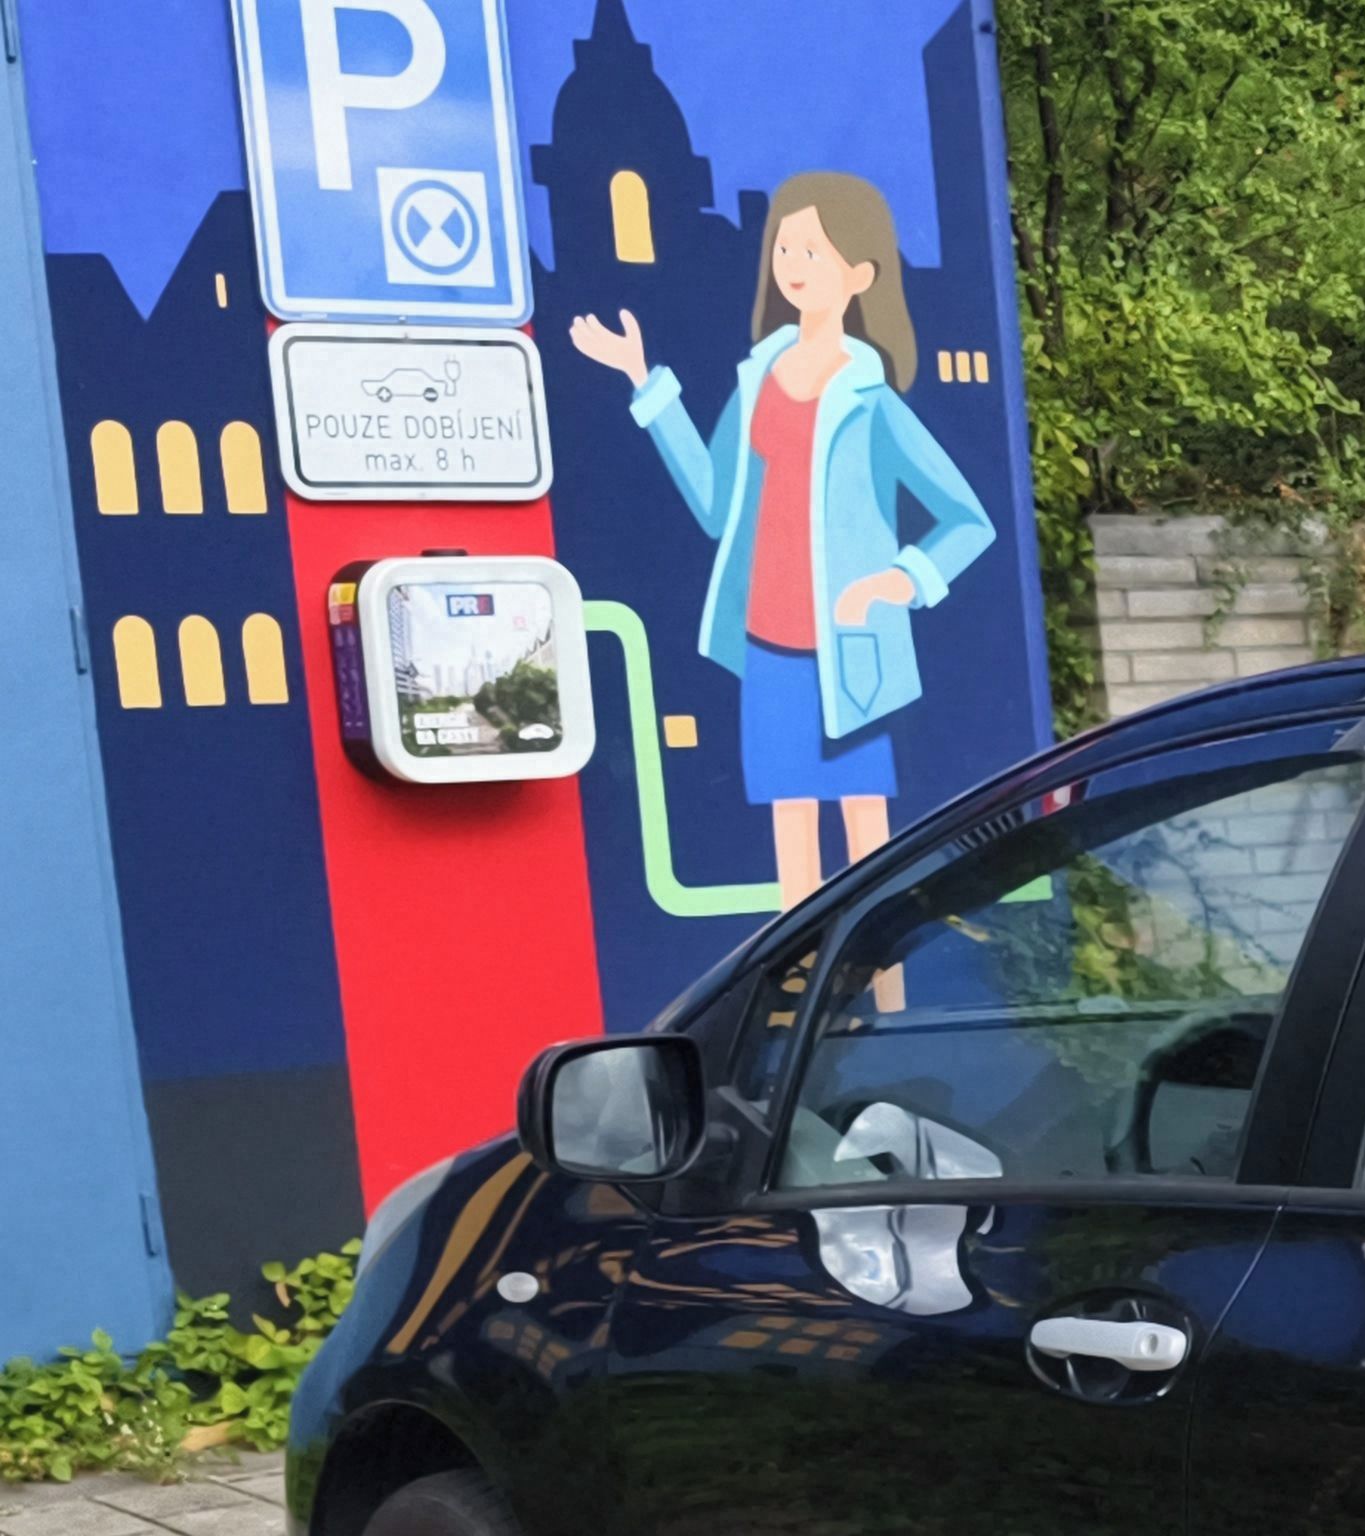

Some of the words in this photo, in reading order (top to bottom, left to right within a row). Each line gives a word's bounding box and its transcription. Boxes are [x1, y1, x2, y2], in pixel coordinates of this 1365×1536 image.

[301, 0, 446, 190] P
[306, 413, 391, 439] POUZE
[404, 409, 523, 441] DOBÍJENÍ
[366, 451, 423, 471] max.
[436, 448, 448, 470] 8
[462, 448, 475, 471] h
